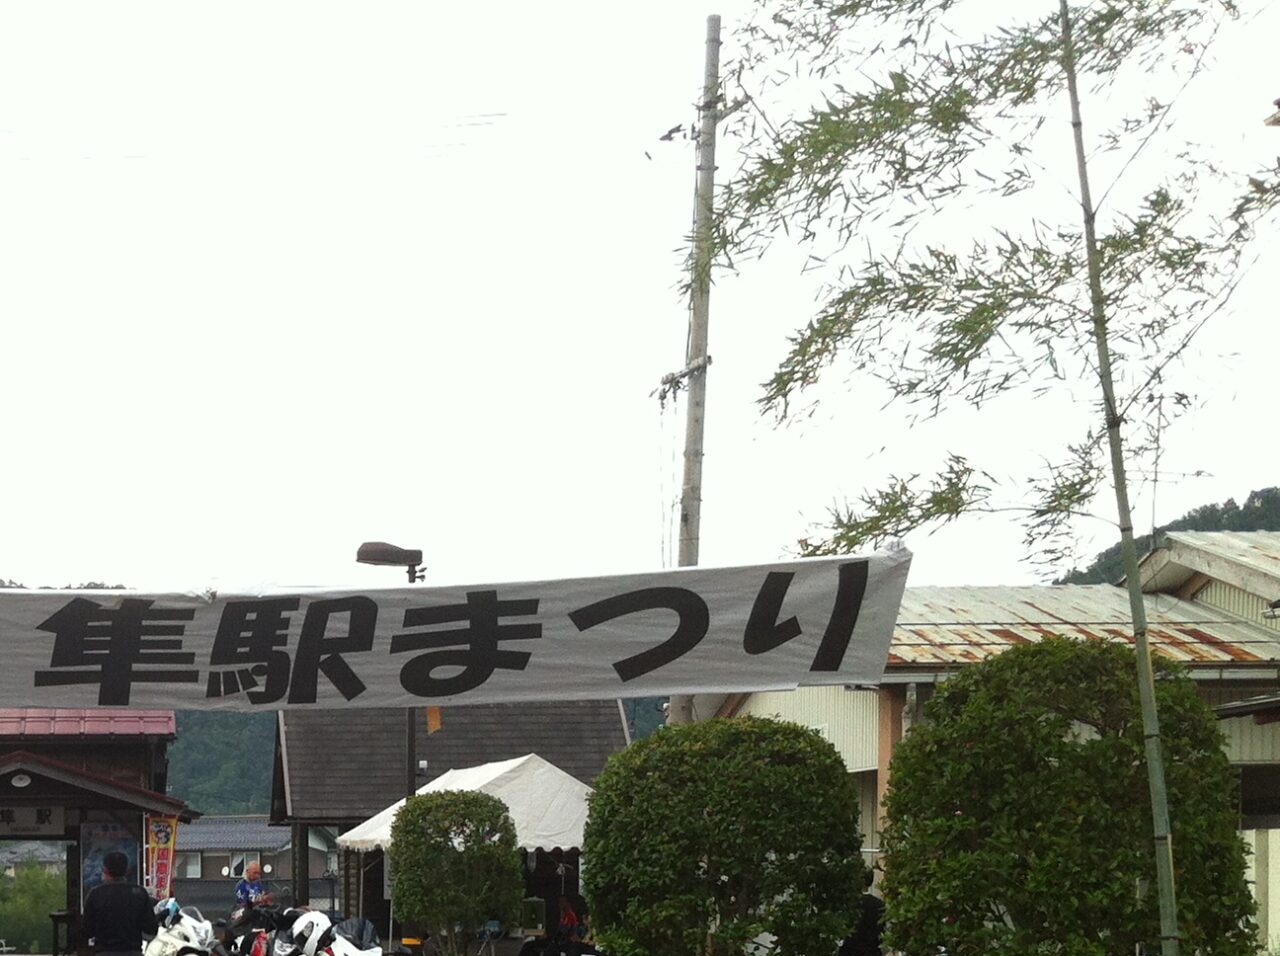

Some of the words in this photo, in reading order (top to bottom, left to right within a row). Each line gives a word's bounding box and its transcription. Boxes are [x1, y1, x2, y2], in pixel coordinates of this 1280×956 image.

[34, 557, 871, 706] 隼駅まつり
